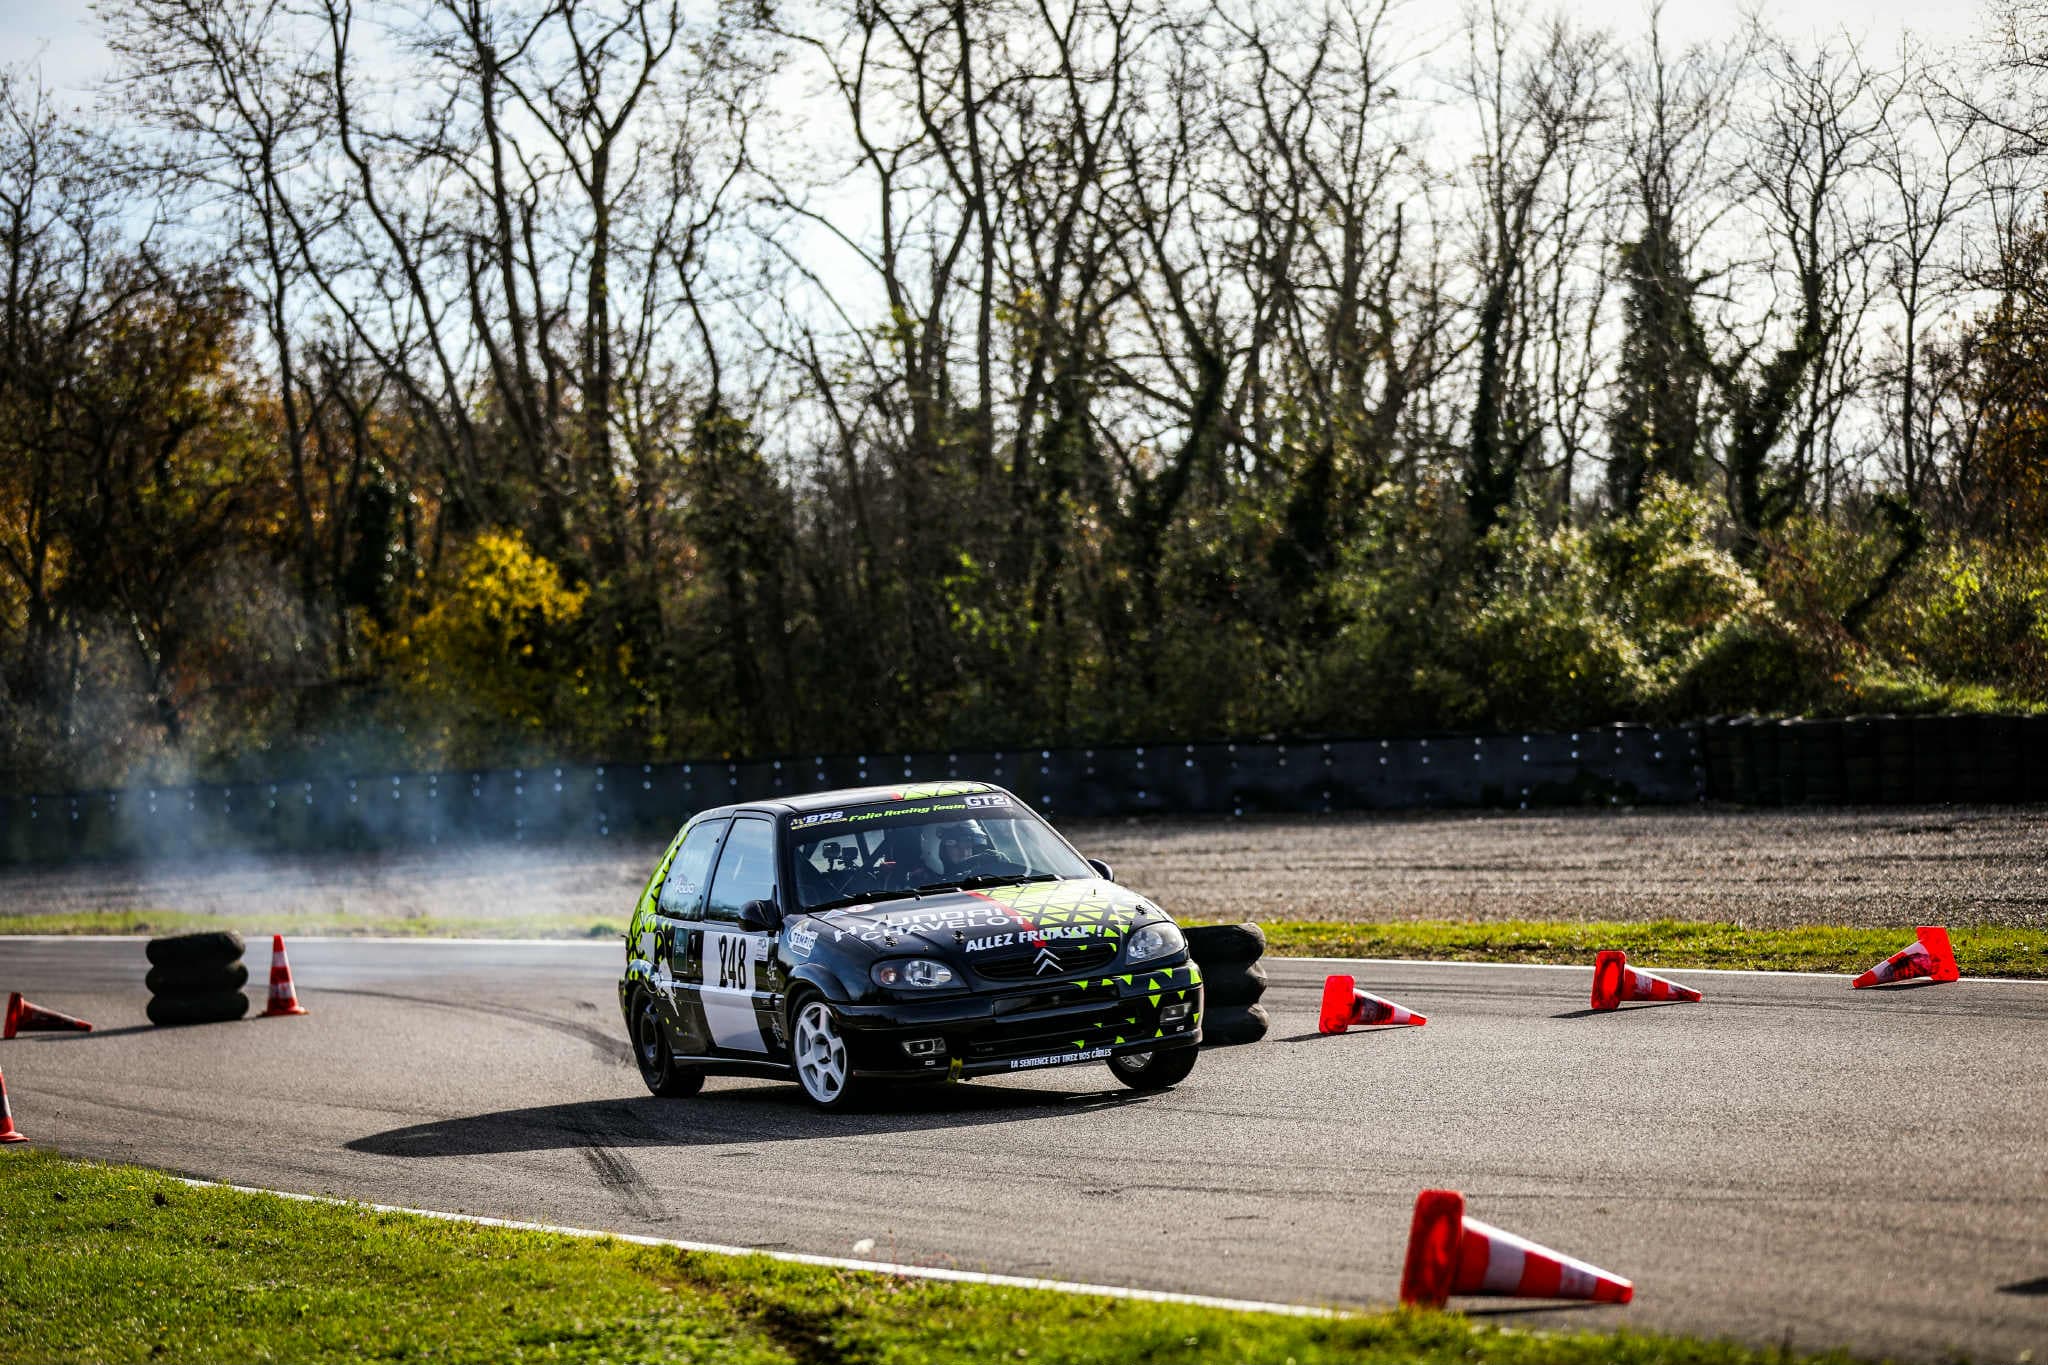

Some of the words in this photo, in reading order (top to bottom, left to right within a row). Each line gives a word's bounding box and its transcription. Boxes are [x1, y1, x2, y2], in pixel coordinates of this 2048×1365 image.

[849, 812, 882, 822] Folio
[884, 807, 930, 817] Racing
[834, 907, 1004, 942] HYUNDAI
[861, 914, 1028, 942] CHAVELOT
[965, 933, 1014, 953] ALLEZ
[1096, 925, 1103, 937] !
[718, 934, 747, 990] 248
[1010, 1060, 1019, 1068] LA
[1019, 1056, 1050, 1067] SENTENCE
[1050, 1055, 1061, 1064] EST
